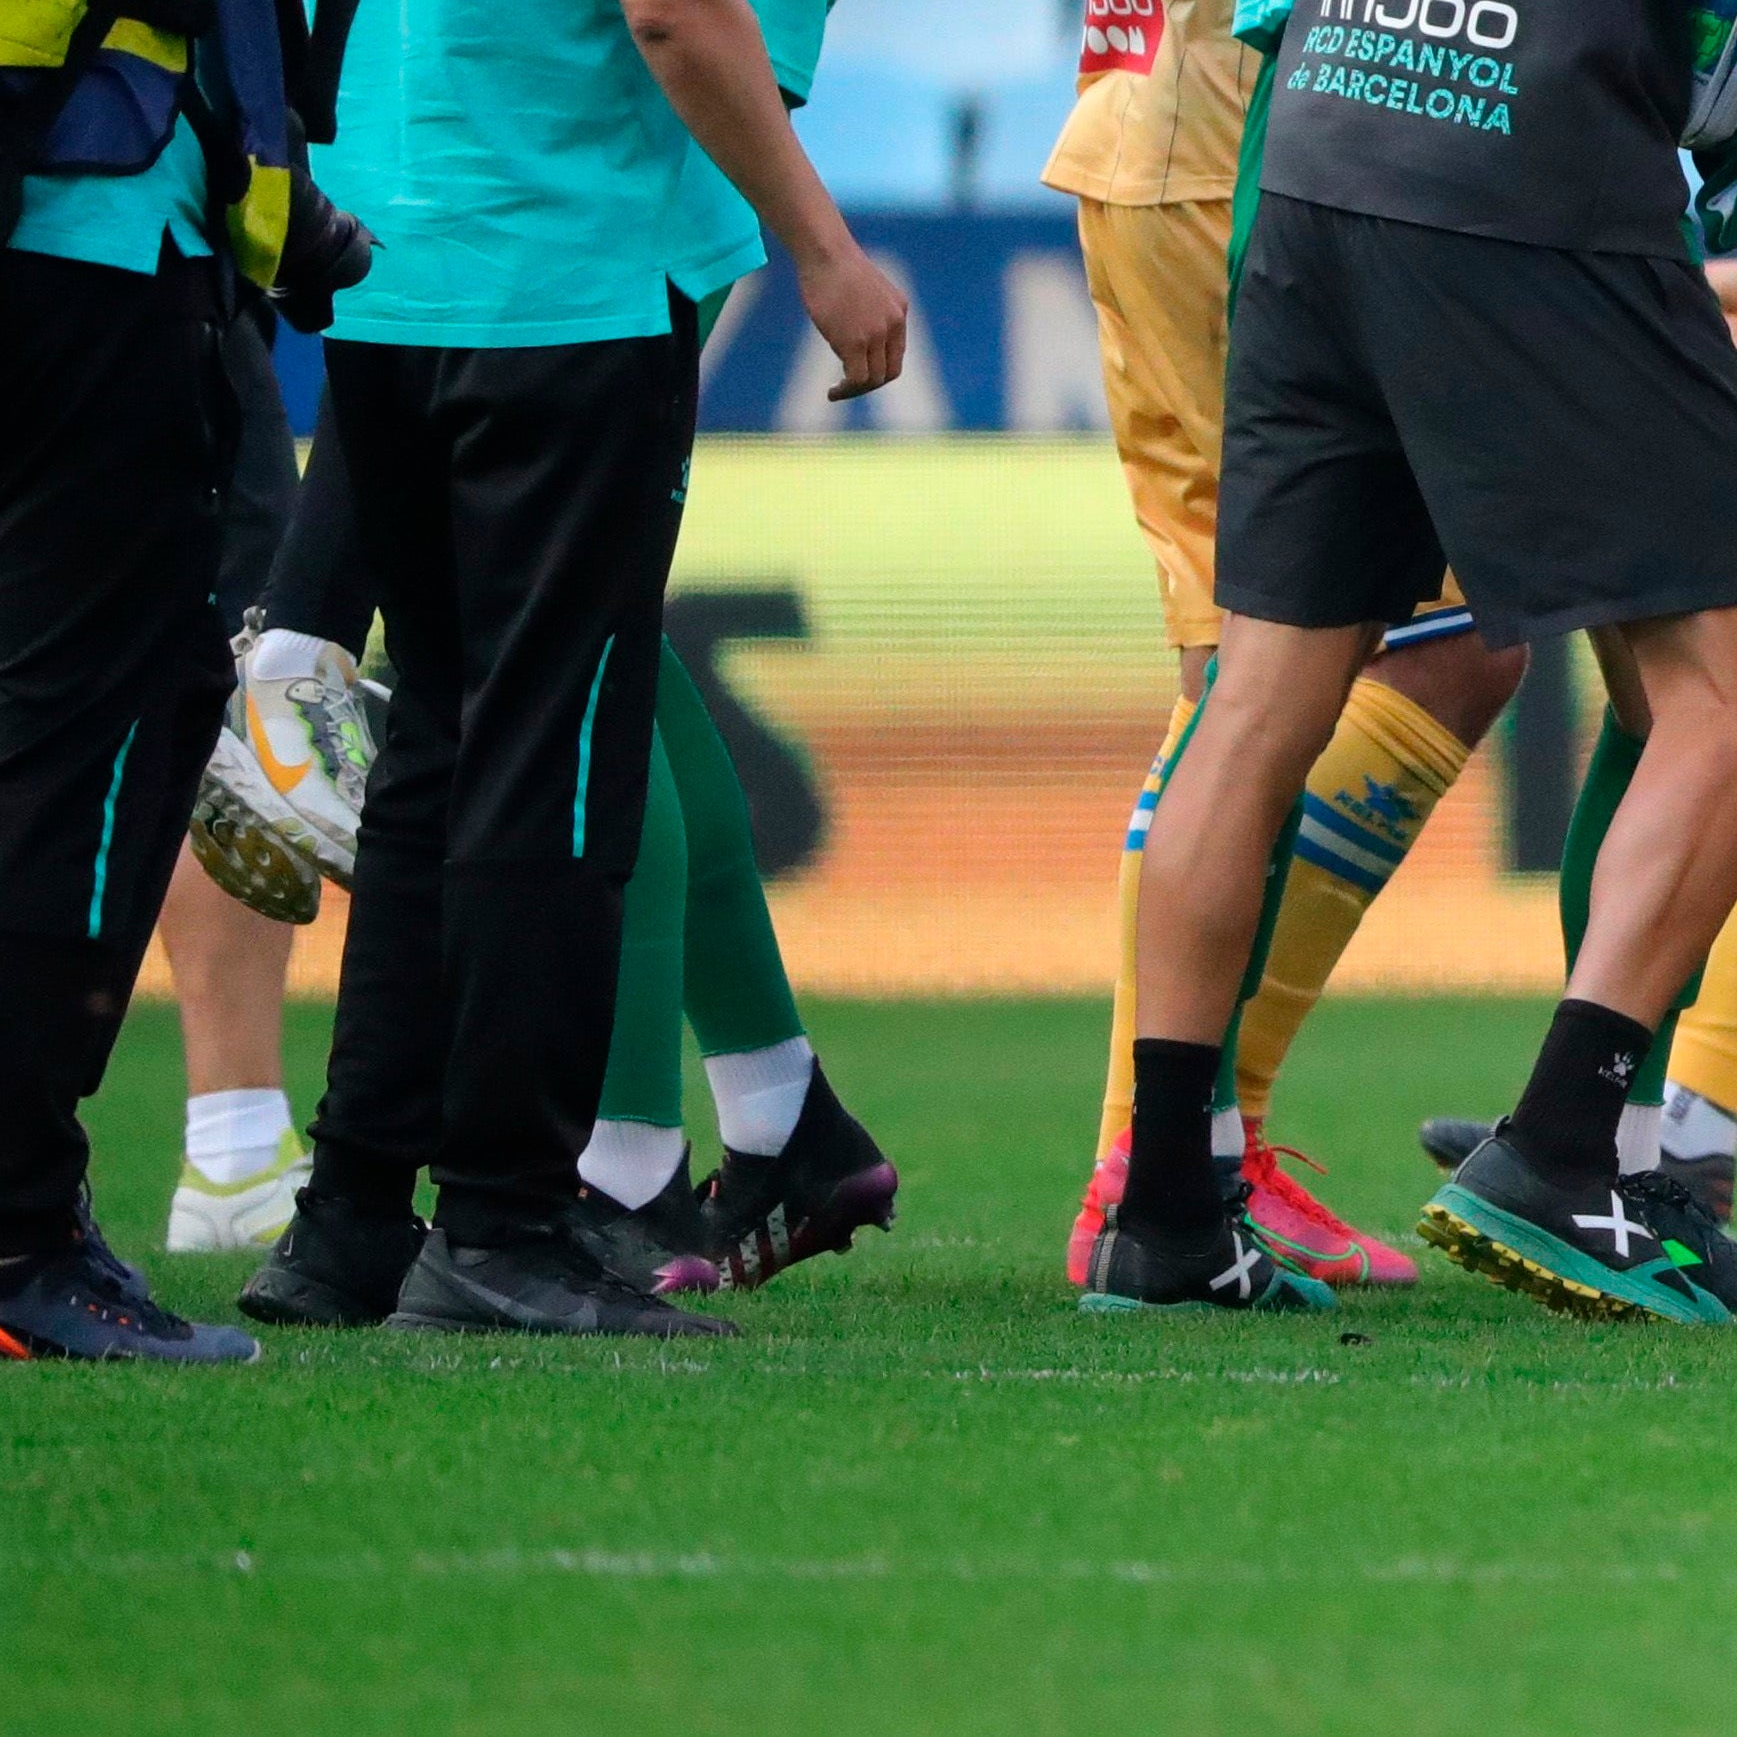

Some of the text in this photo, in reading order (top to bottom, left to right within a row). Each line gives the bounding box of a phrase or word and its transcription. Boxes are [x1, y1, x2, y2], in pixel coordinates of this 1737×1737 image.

[1302, 24, 1521, 95] RCD ESPANYOL
[1286, 61, 1513, 136] de BARCELONA
